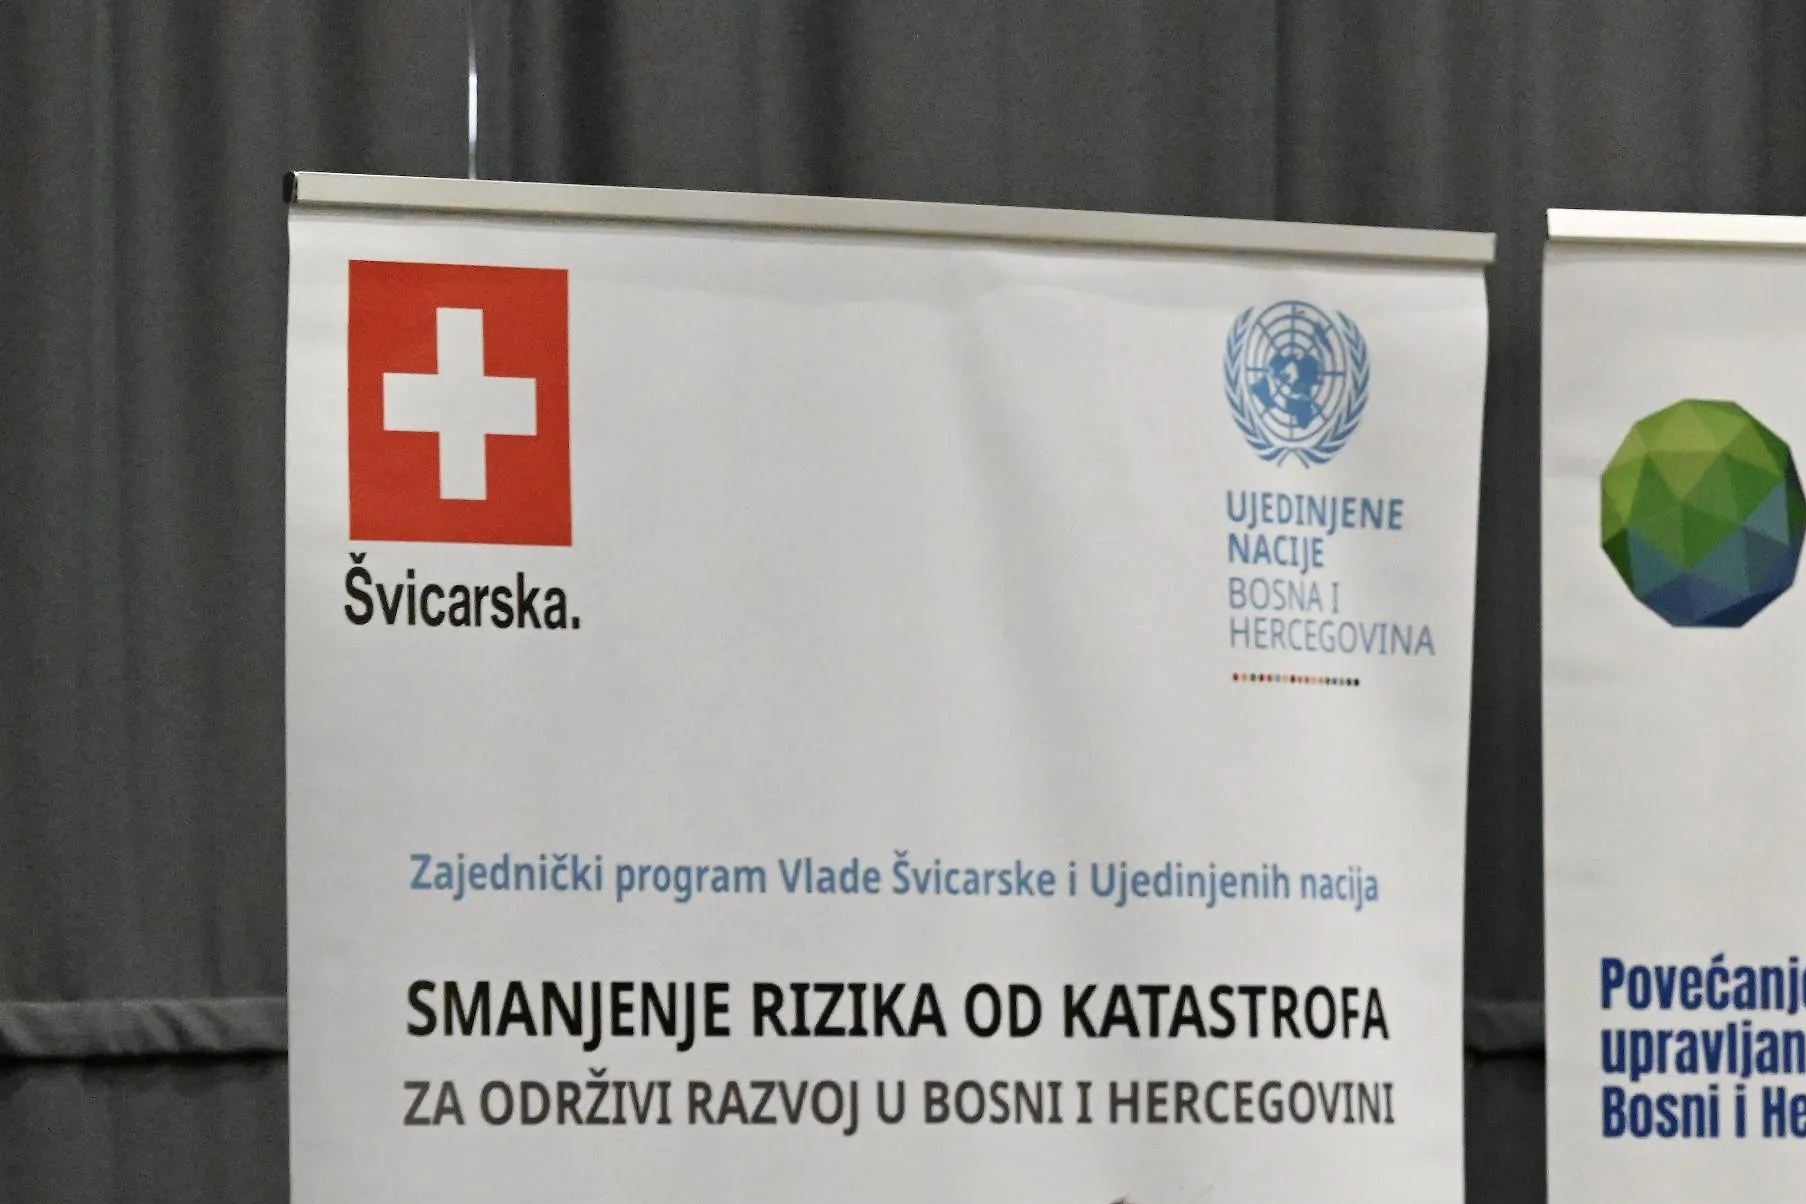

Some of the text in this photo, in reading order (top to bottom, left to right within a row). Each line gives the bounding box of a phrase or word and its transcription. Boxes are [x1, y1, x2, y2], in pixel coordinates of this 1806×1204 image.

[1226, 490, 1406, 533] UJEDINJENE
[1227, 533, 1326, 573] NACIJE
[344, 551, 581, 630] Švicarska.
[1228, 576, 1340, 615] BOSNA I
[1229, 616, 1437, 657] HERCEGOVINA
[410, 849, 1379, 912] Zajednički program Vlade Švicarske i Ujedinjenih nacija
[407, 979, 1390, 1053] SMANJENJE RIZIKA OD KATASTROFA
[403, 1067, 1395, 1136] ZA ODRŽIVI RAZVOJ U BOSNI I HERCEGOVINI
[1602, 1083, 1720, 1139] Bosni
[1735, 1083, 1747, 1139] i
